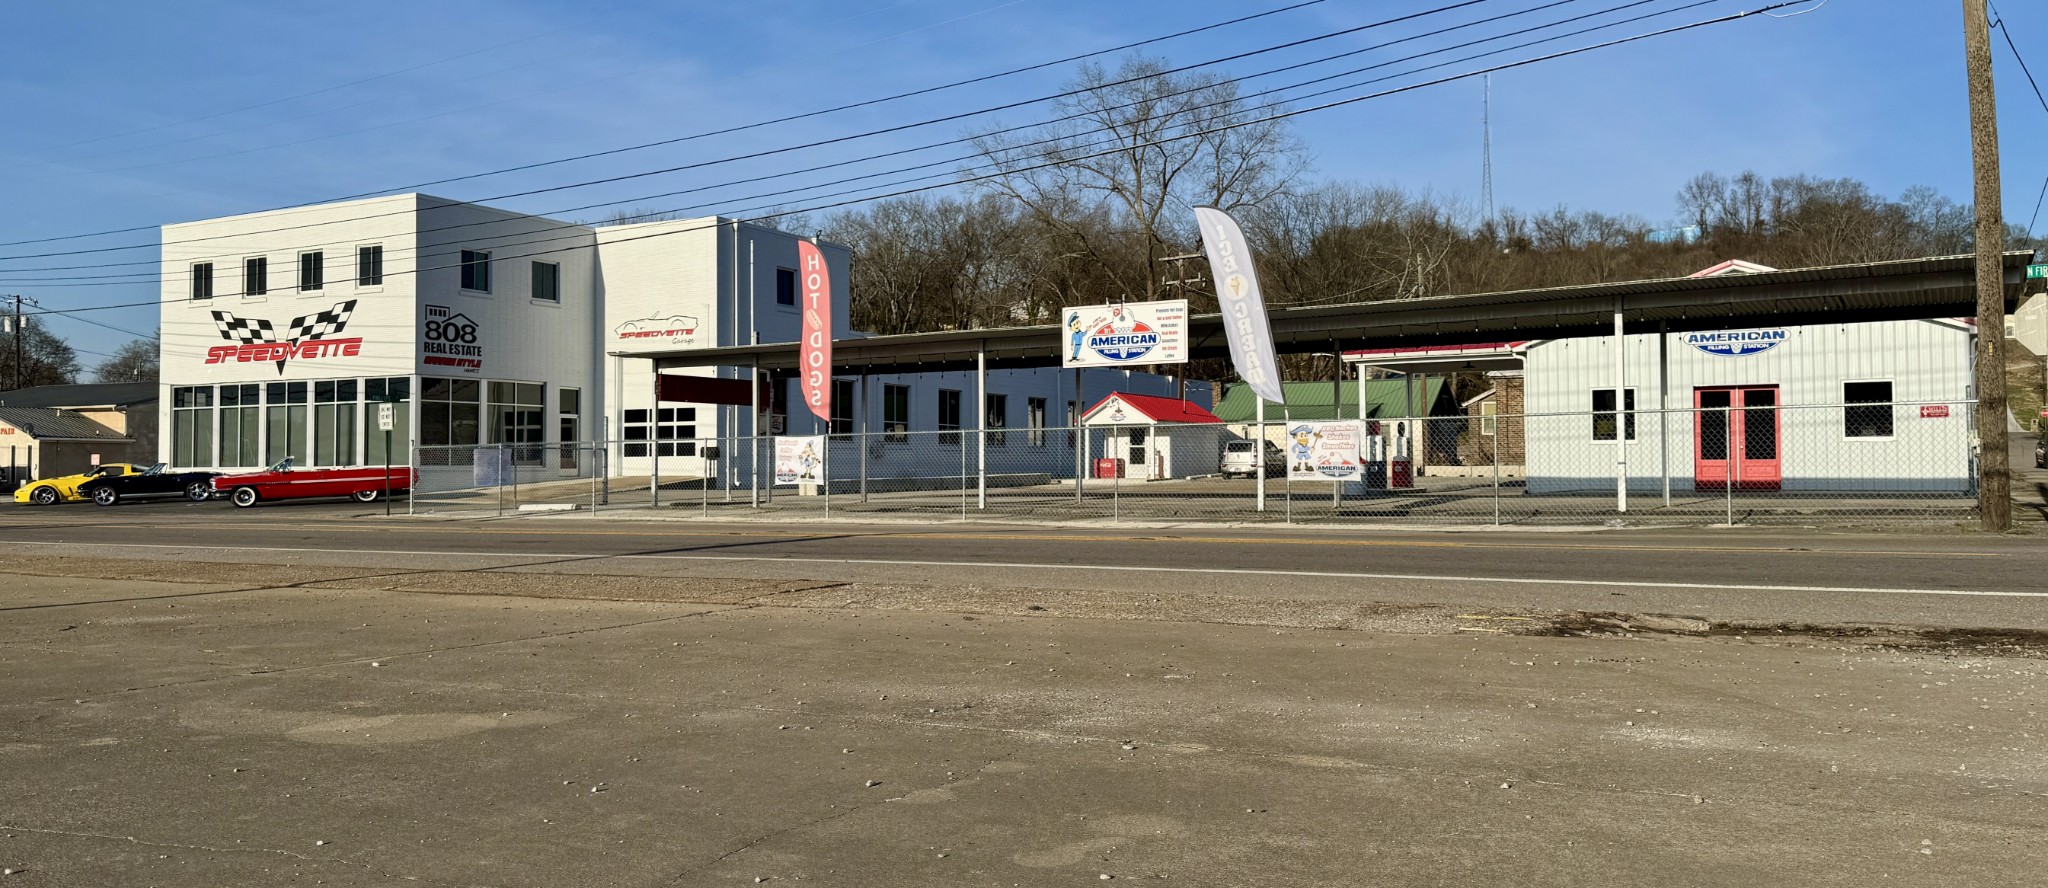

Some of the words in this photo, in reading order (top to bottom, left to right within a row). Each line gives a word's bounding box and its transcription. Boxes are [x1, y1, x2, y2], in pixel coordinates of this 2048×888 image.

[2027, 266, 2033, 277] N
[425, 320, 478, 344] 808
[619, 329, 695, 340] SPEEDVETTE
[1688, 331, 1785, 343] AMERICAN
[672, 337, 696, 345] Garage
[1090, 334, 1157, 347] AMERICAN
[1743, 342, 1770, 350] STATION
[205, 337, 363, 364] SPEEDVETTE
[424, 342, 447, 354] REAL
[449, 344, 482, 357] ESTATE
[1322, 441, 1355, 449] Smoothies
